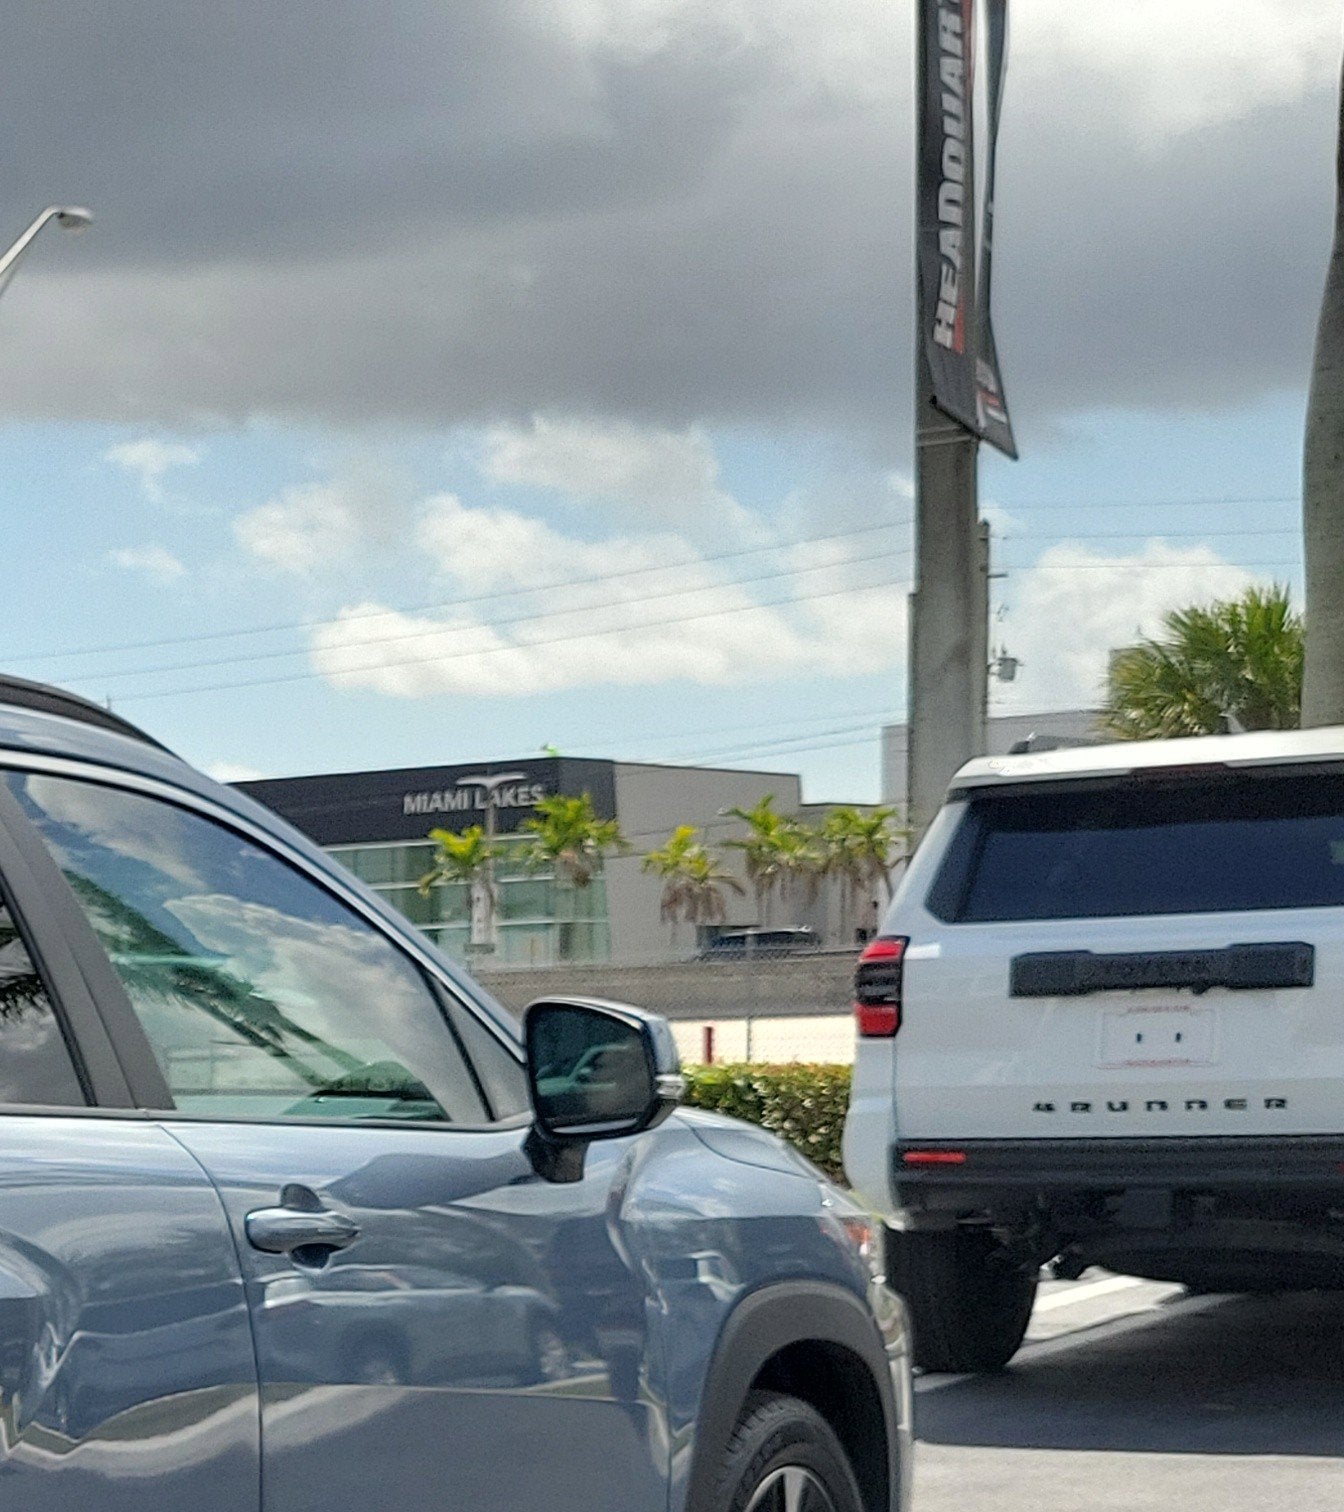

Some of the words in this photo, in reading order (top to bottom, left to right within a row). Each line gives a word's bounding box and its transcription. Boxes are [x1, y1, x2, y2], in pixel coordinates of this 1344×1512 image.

[403, 789, 470, 815] MIAMI
[474, 784, 545, 810] LAKES
[1033, 1098, 1288, 1113] 4RUNNER
